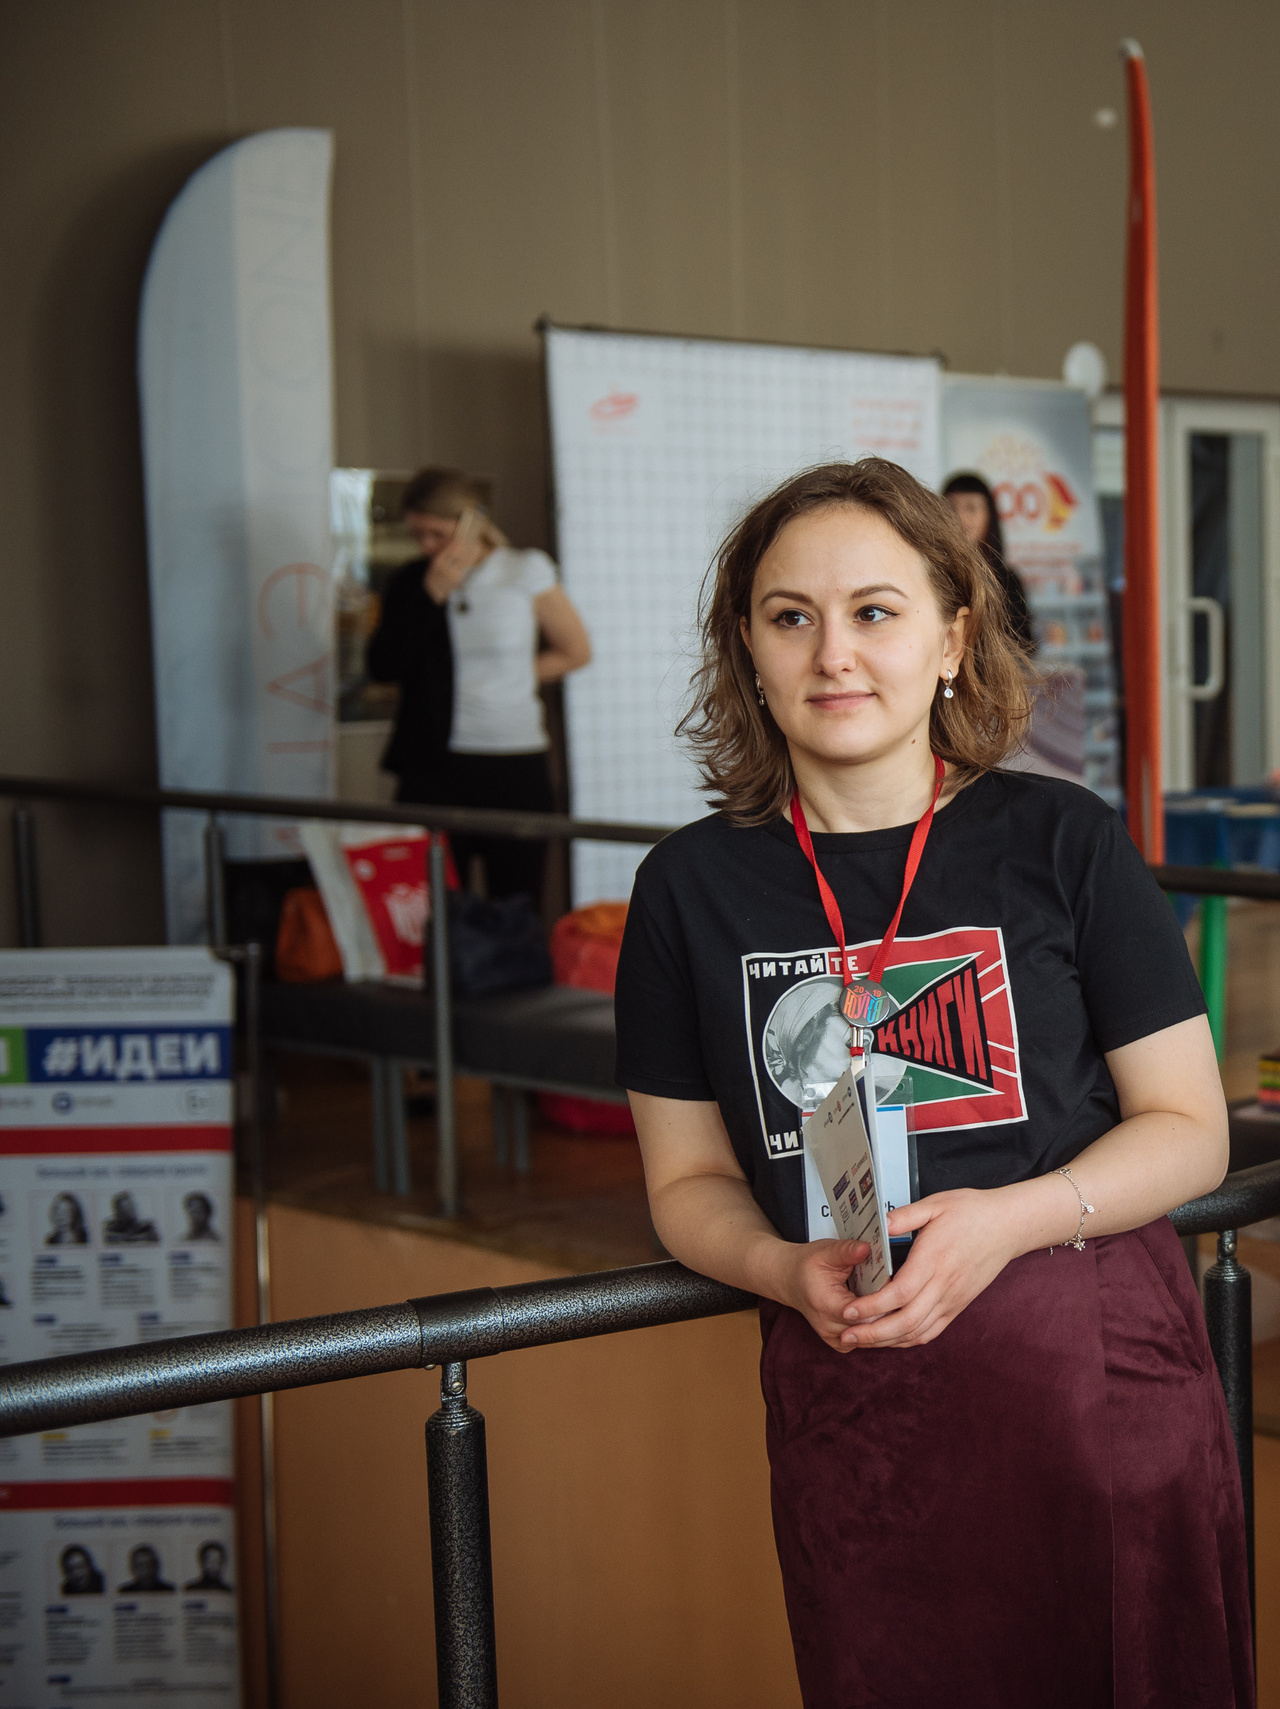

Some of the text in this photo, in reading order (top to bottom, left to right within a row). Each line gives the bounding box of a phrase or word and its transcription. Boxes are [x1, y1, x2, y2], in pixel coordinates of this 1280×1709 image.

[748, 954, 860, 979] ЧИТАЙТЕ
[853, 985, 882, 997] 20 19
[877, 968, 988, 1081] КНИГИ
[42, 1032, 221, 1081] #ИДЕИ
[769, 1131, 800, 1151] ЧИ
